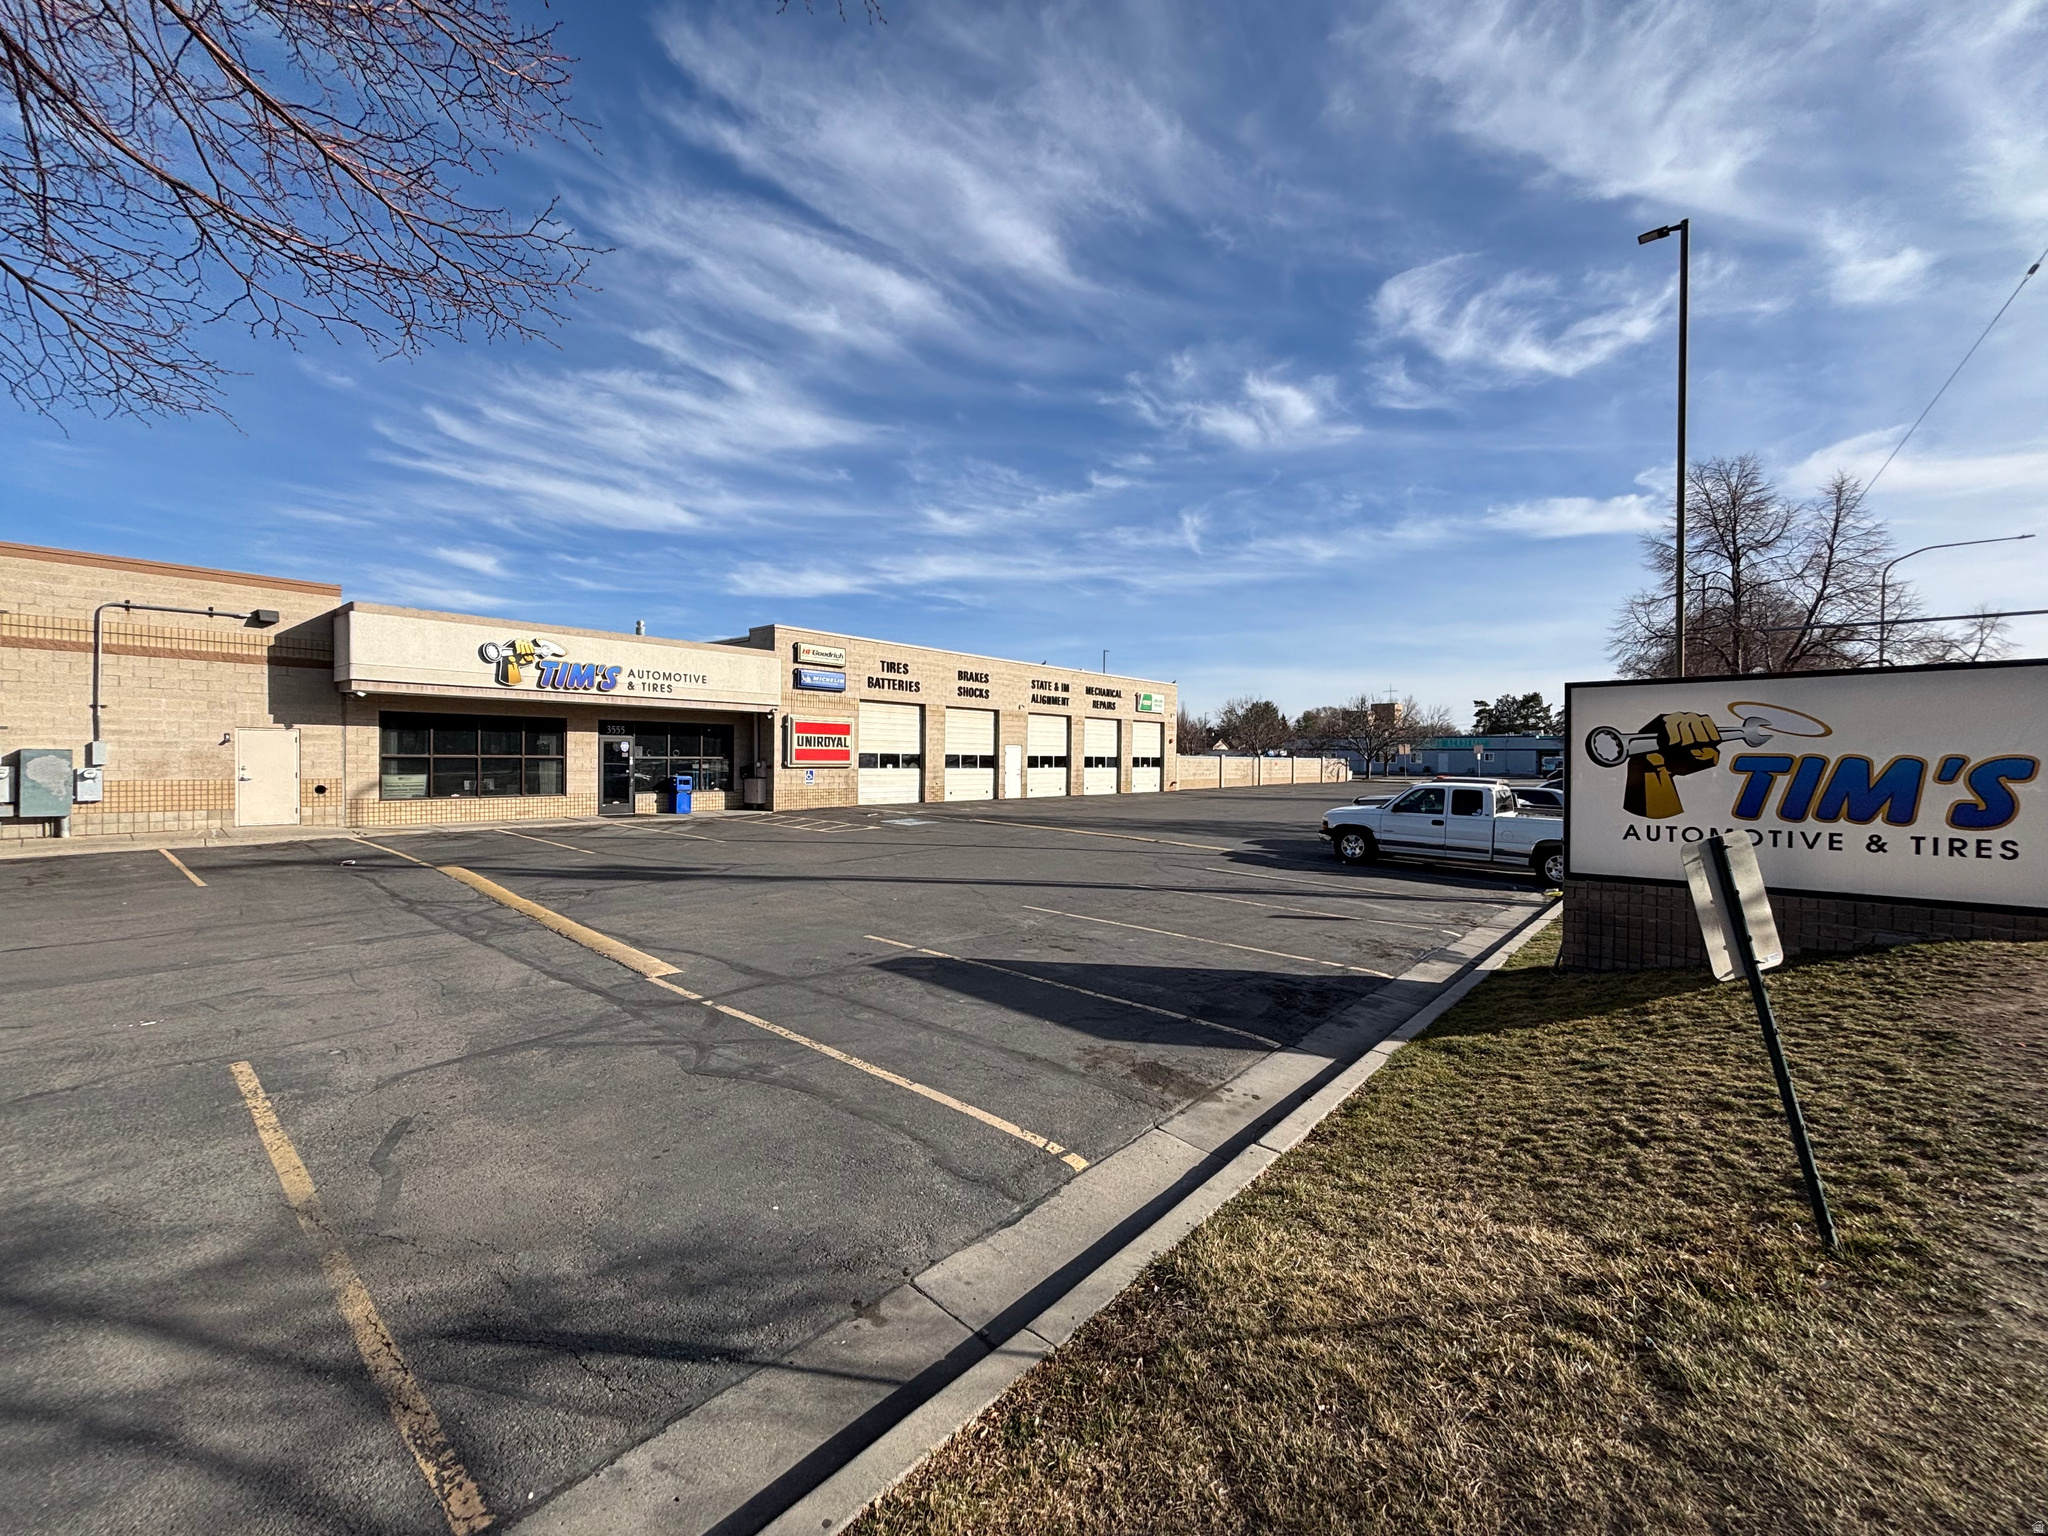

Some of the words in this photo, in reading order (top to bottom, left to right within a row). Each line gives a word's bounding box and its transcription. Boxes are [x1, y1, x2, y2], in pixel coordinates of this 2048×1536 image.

[880, 660, 909, 675] TIRES
[537, 660, 623, 691] TIM'S
[627, 669, 707, 684] AUTOMOTIVE
[812, 675, 845, 684] MICHELIN
[957, 670, 990, 684] BRAKES
[627, 682, 635, 691] &
[642, 682, 673, 694] TIRES
[867, 676, 921, 693] BATTERIES
[1031, 680, 1052, 691] STATE
[1054, 681, 1059, 692] &
[957, 686, 990, 699] SHOCKS
[1085, 686, 1123, 699] MECHANICAL
[1031, 694, 1070, 707] ALIGNMENT
[1092, 700, 1117, 711] REPAIRS
[606, 725, 626, 735] 3555
[797, 735, 850, 748] UNIROYAL
[1729, 753, 2040, 832] TIM'S
[1866, 834, 1889, 854] &
[1910, 835, 2021, 861] TIRES
